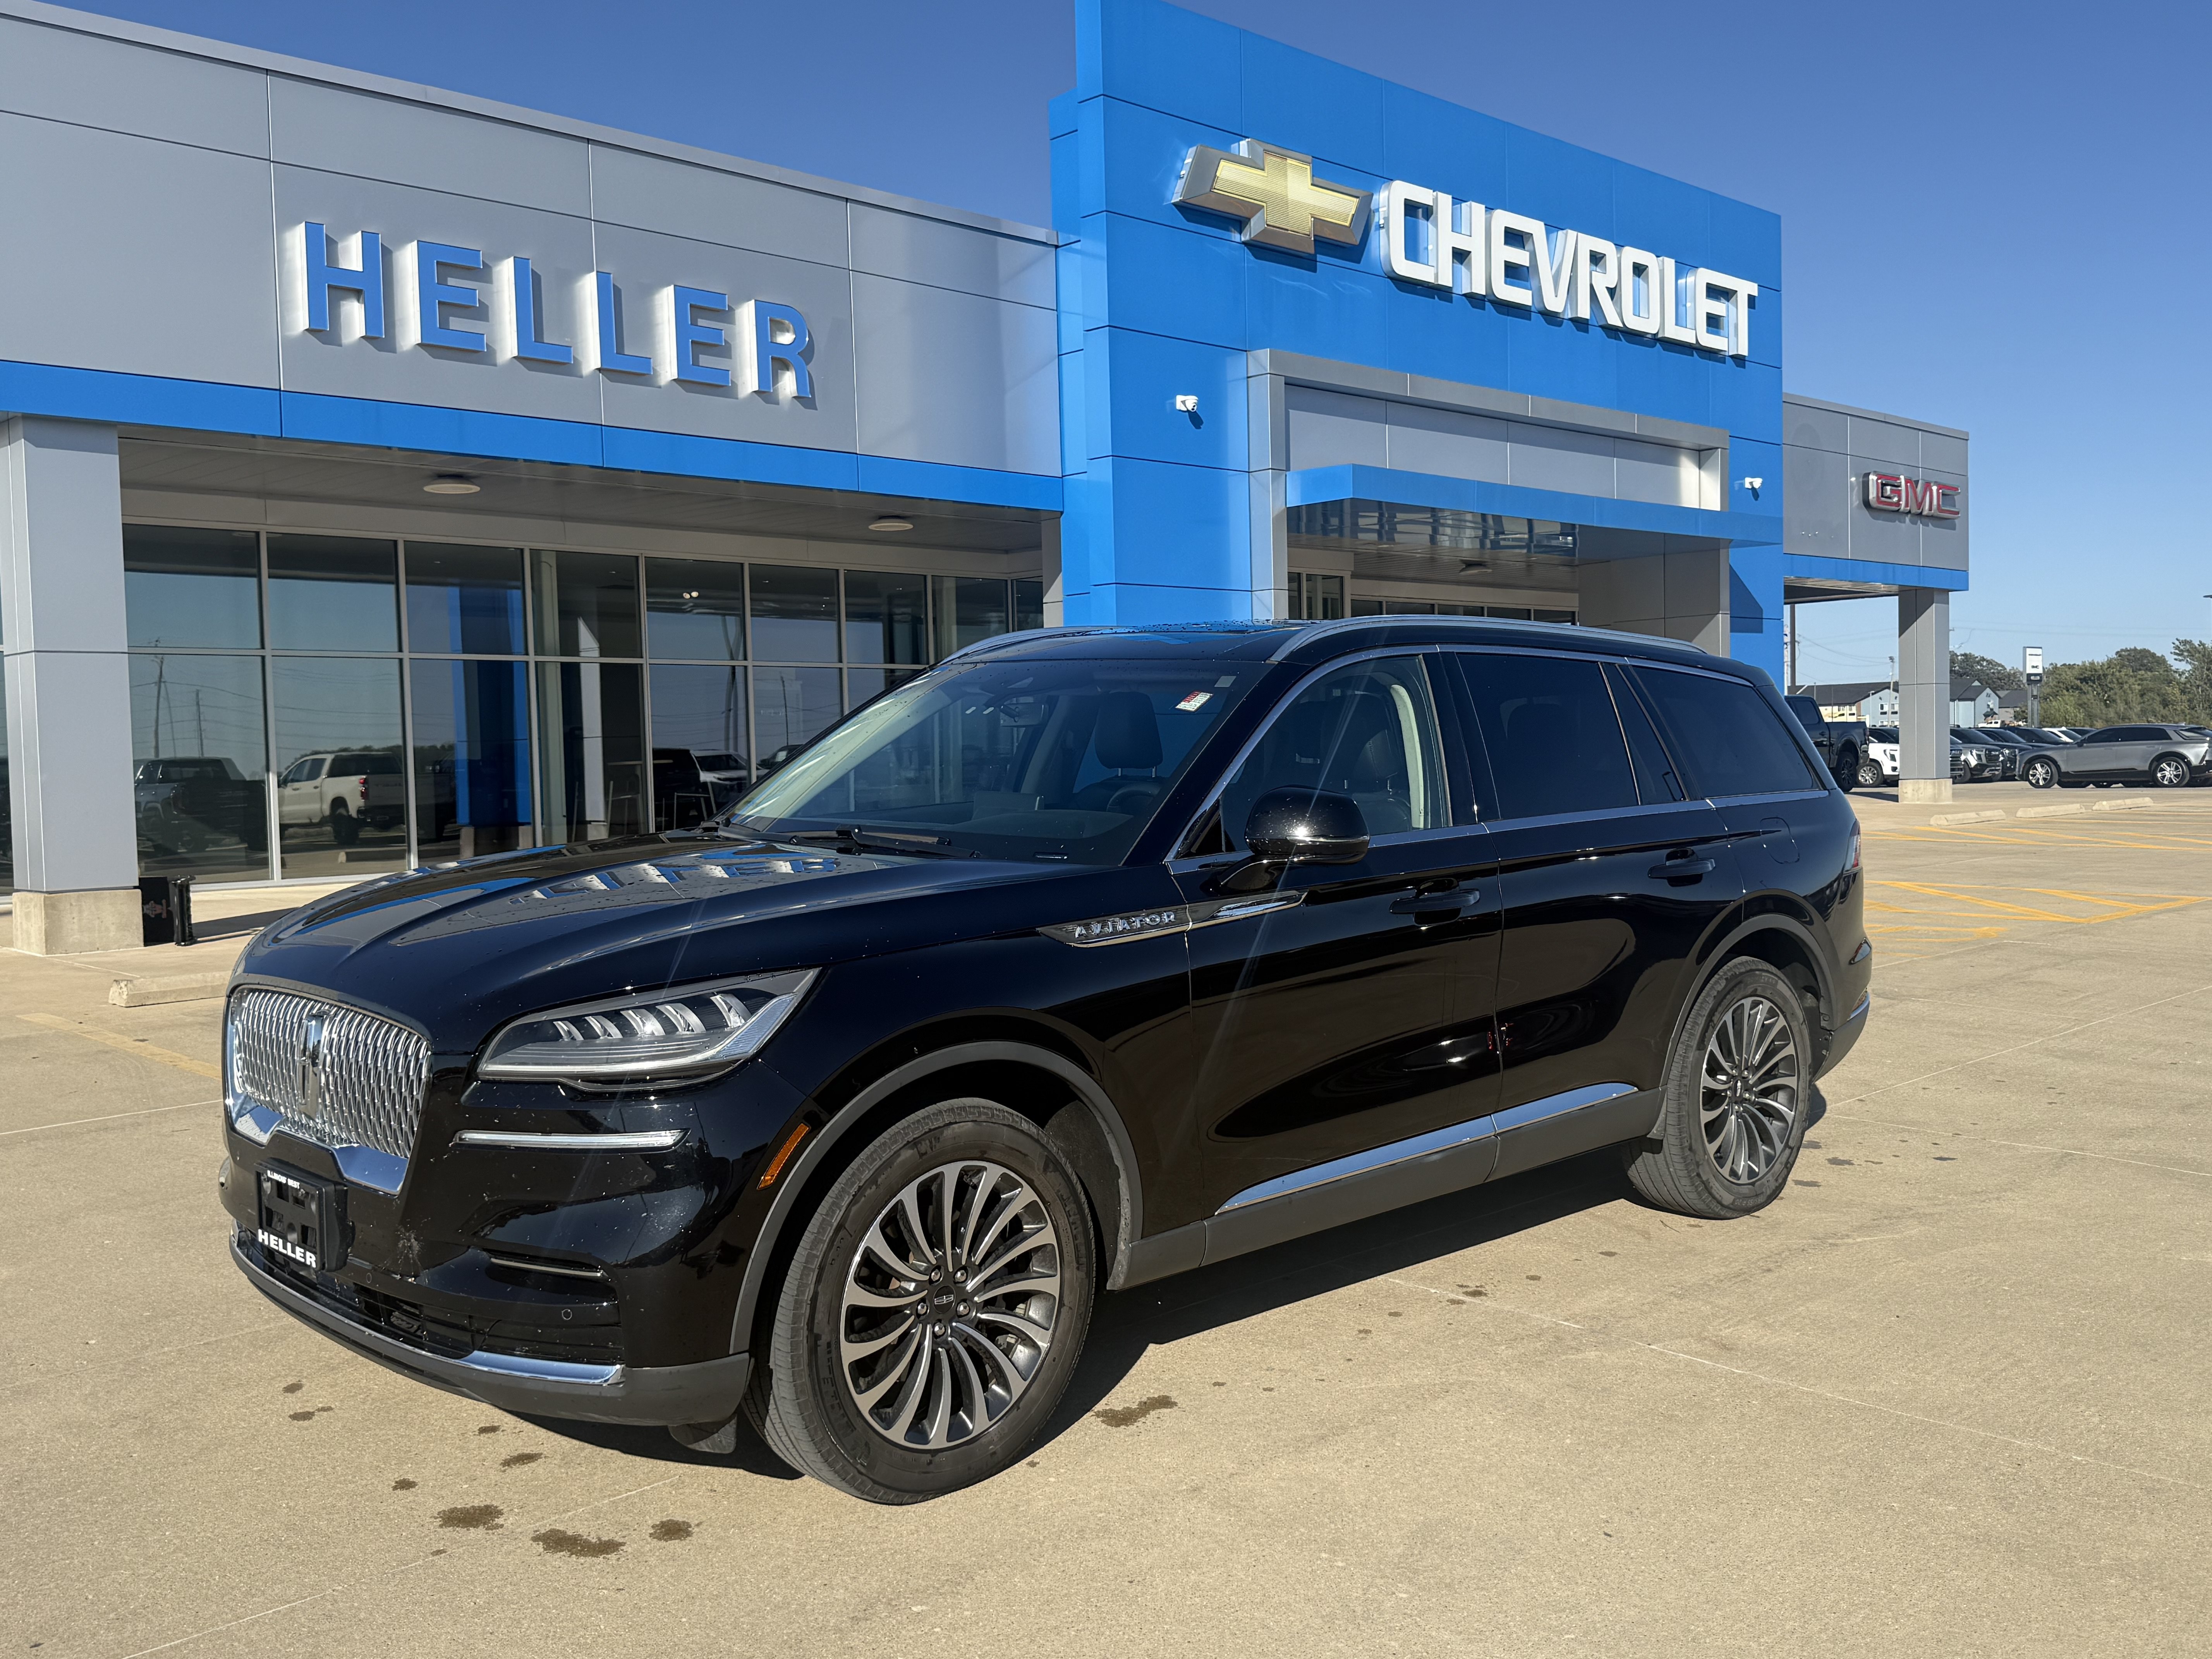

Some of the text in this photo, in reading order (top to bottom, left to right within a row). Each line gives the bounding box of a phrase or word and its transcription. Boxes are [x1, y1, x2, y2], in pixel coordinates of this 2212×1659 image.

[1379, 180, 1759, 357] CHEVROLET
[299, 221, 812, 398] HELLER
[1863, 471, 1961, 519] GMC
[1075, 911, 1176, 938] AVIATOR
[258, 1229, 316, 1268] HELLER
